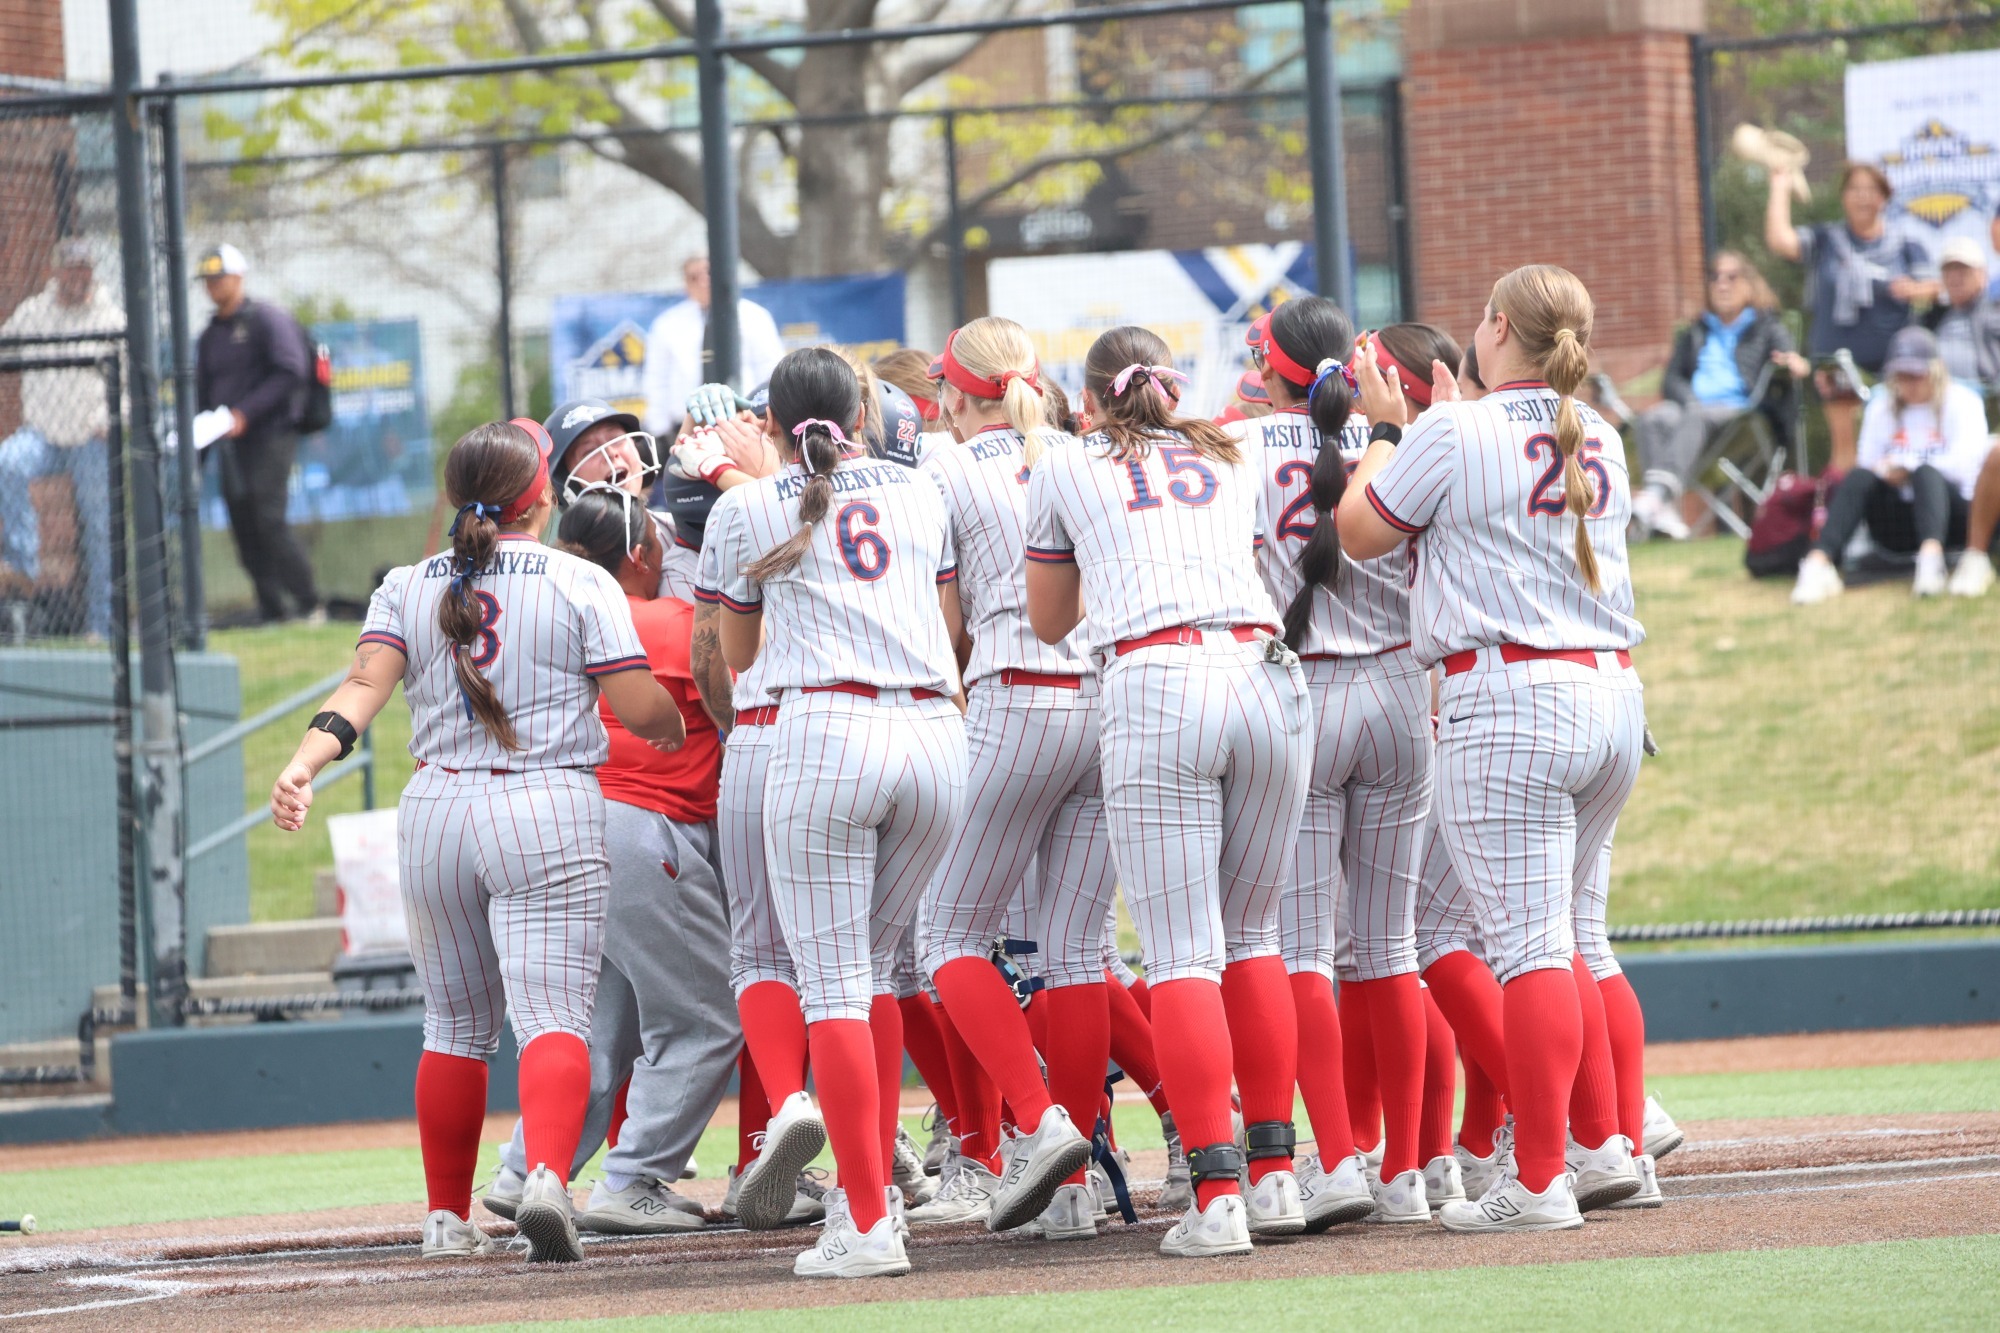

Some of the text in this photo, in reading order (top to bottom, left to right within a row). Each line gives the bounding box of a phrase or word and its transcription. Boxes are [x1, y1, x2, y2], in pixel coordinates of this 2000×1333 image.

[1500, 399, 1543, 422] MSU
[897, 419, 917, 443] 22
[1261, 424, 1302, 448] MSU
[968, 437, 1013, 462] MSU
[1113, 446, 1222, 512] 15
[1523, 432, 1613, 518] 25
[836, 501, 891, 582] 6
[473, 551, 549, 577] ENVER
